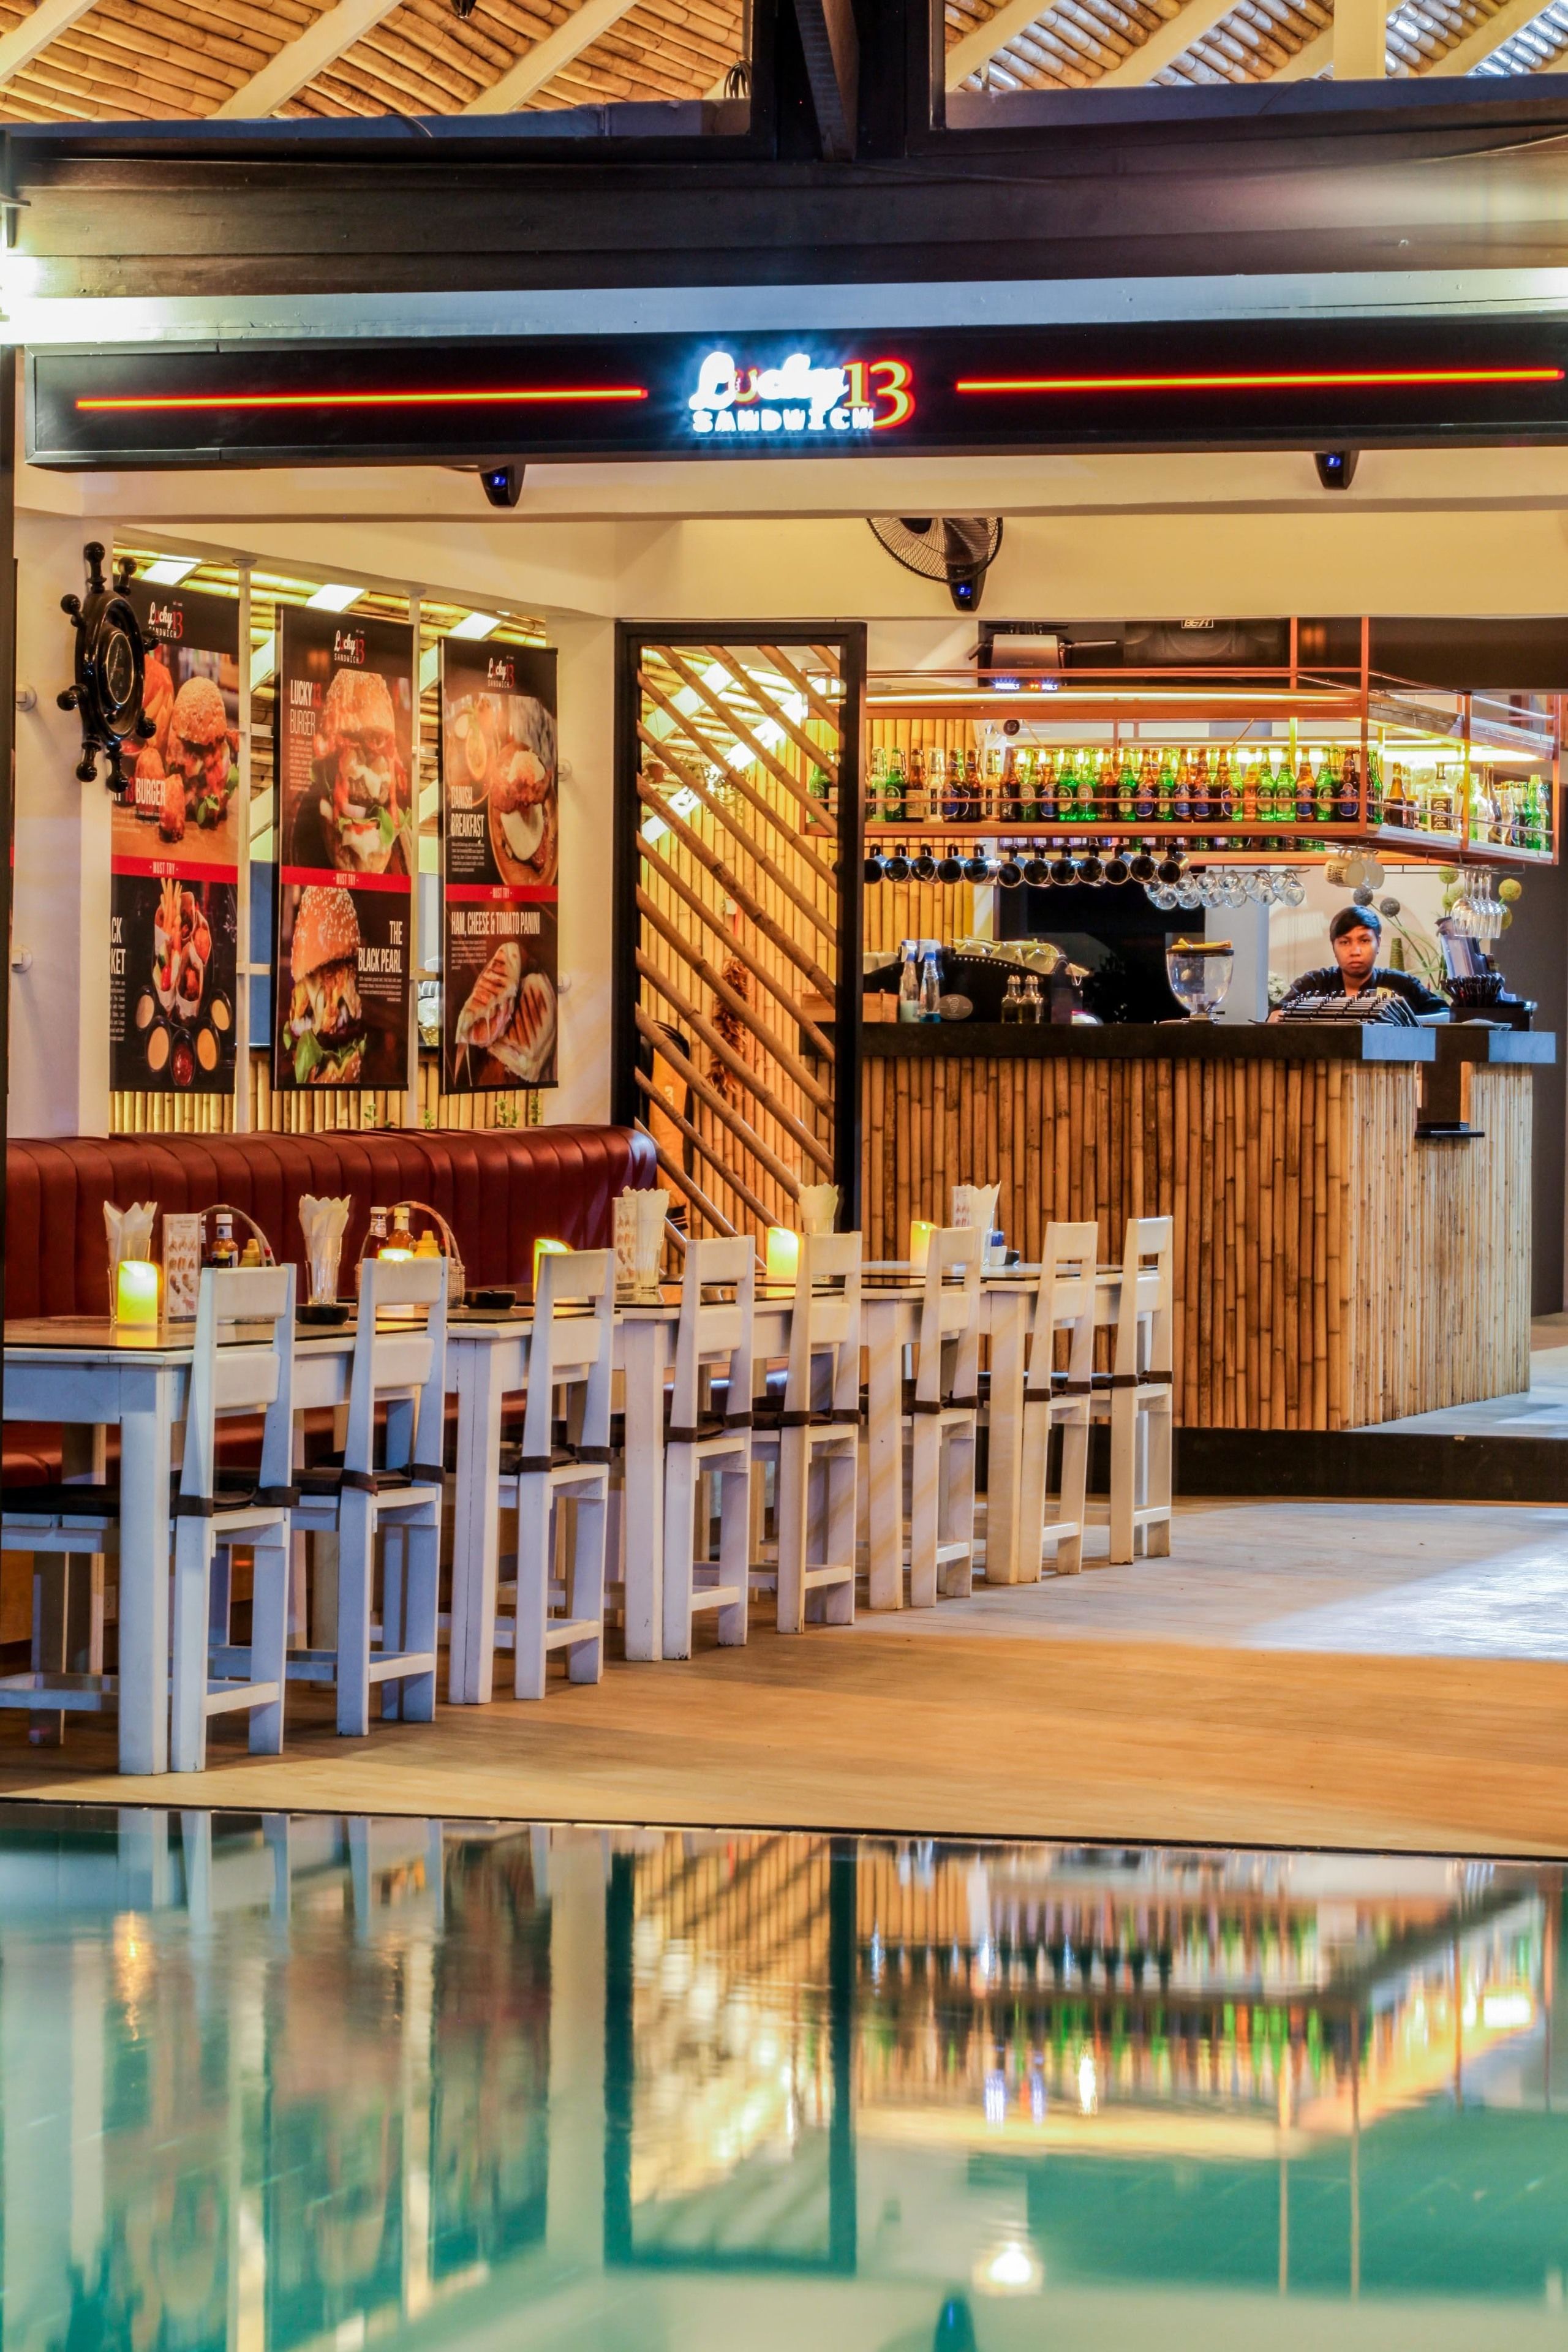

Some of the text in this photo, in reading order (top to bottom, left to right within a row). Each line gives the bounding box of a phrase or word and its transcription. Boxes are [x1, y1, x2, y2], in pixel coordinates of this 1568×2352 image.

[842, 356, 915, 430] 13
[693, 407, 873, 432] SANDWICH
[148, 601, 183, 639] Lucky 13
[334, 630, 365, 665] Lucky 13
[334, 652, 359, 664] SANDWICH
[487, 657, 507, 680] Lucky
[290, 679, 322, 708] LUCKY 13
[290, 708, 316, 736] BURGER
[136, 777, 165, 806] BURGER
[451, 785, 473, 809] DANISH
[451, 813, 484, 838] BREAKFAST
[153, 861, 176, 875] MUST TRY
[336, 872, 356, 886] MUST TRY
[492, 888, 503, 899] MUST
[111, 917, 123, 944] CK
[390, 920, 402, 945] THE
[451, 911, 467, 937] HAM,
[467, 911, 489, 935] CHEESE
[496, 911, 519, 935] TOMATO
[521, 911, 540, 935] PANINI
[111, 948, 126, 975] KET
[358, 948, 402, 973] BLACK PEARL
